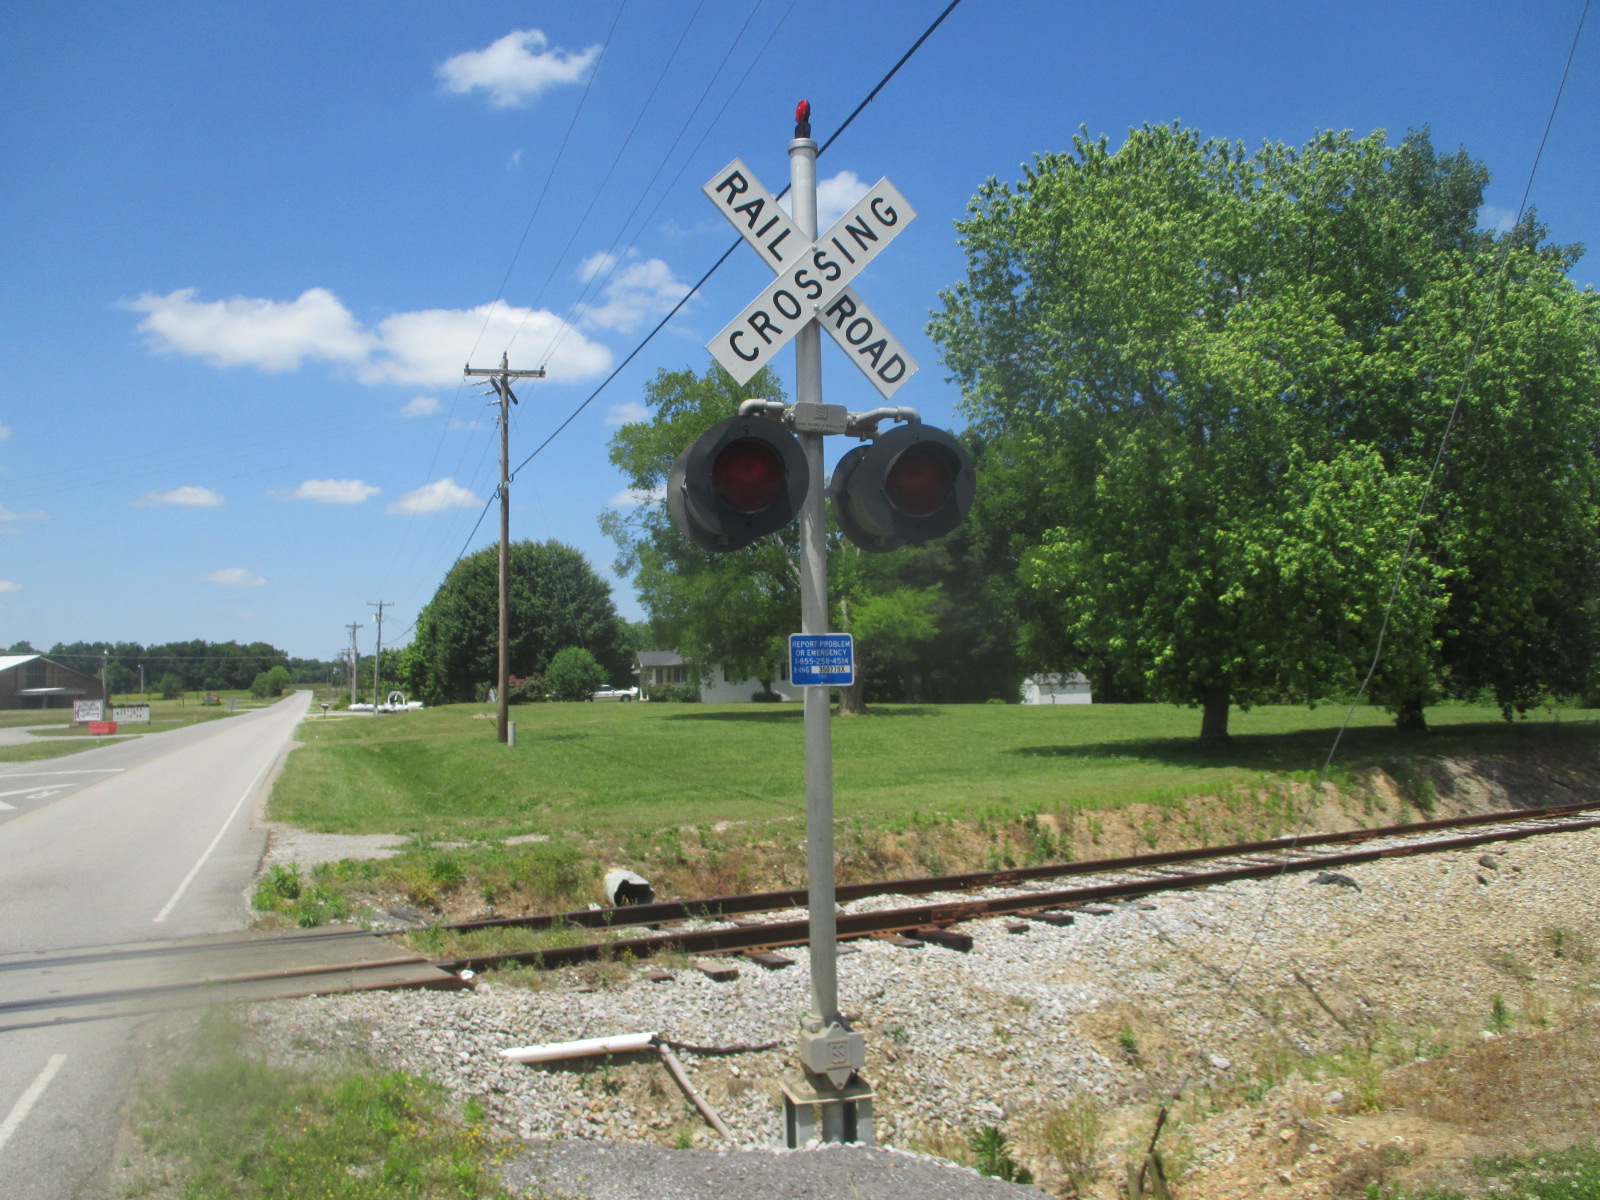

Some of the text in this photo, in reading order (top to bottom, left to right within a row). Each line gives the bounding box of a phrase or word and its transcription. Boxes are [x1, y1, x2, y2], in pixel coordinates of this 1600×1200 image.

[715, 169, 907, 384] RAIL ROAD
[729, 197, 898, 362] CROSSING
[792, 640, 850, 648] REPORT PROBLEM
[794, 657, 849, 665] 1-855-258-4514
